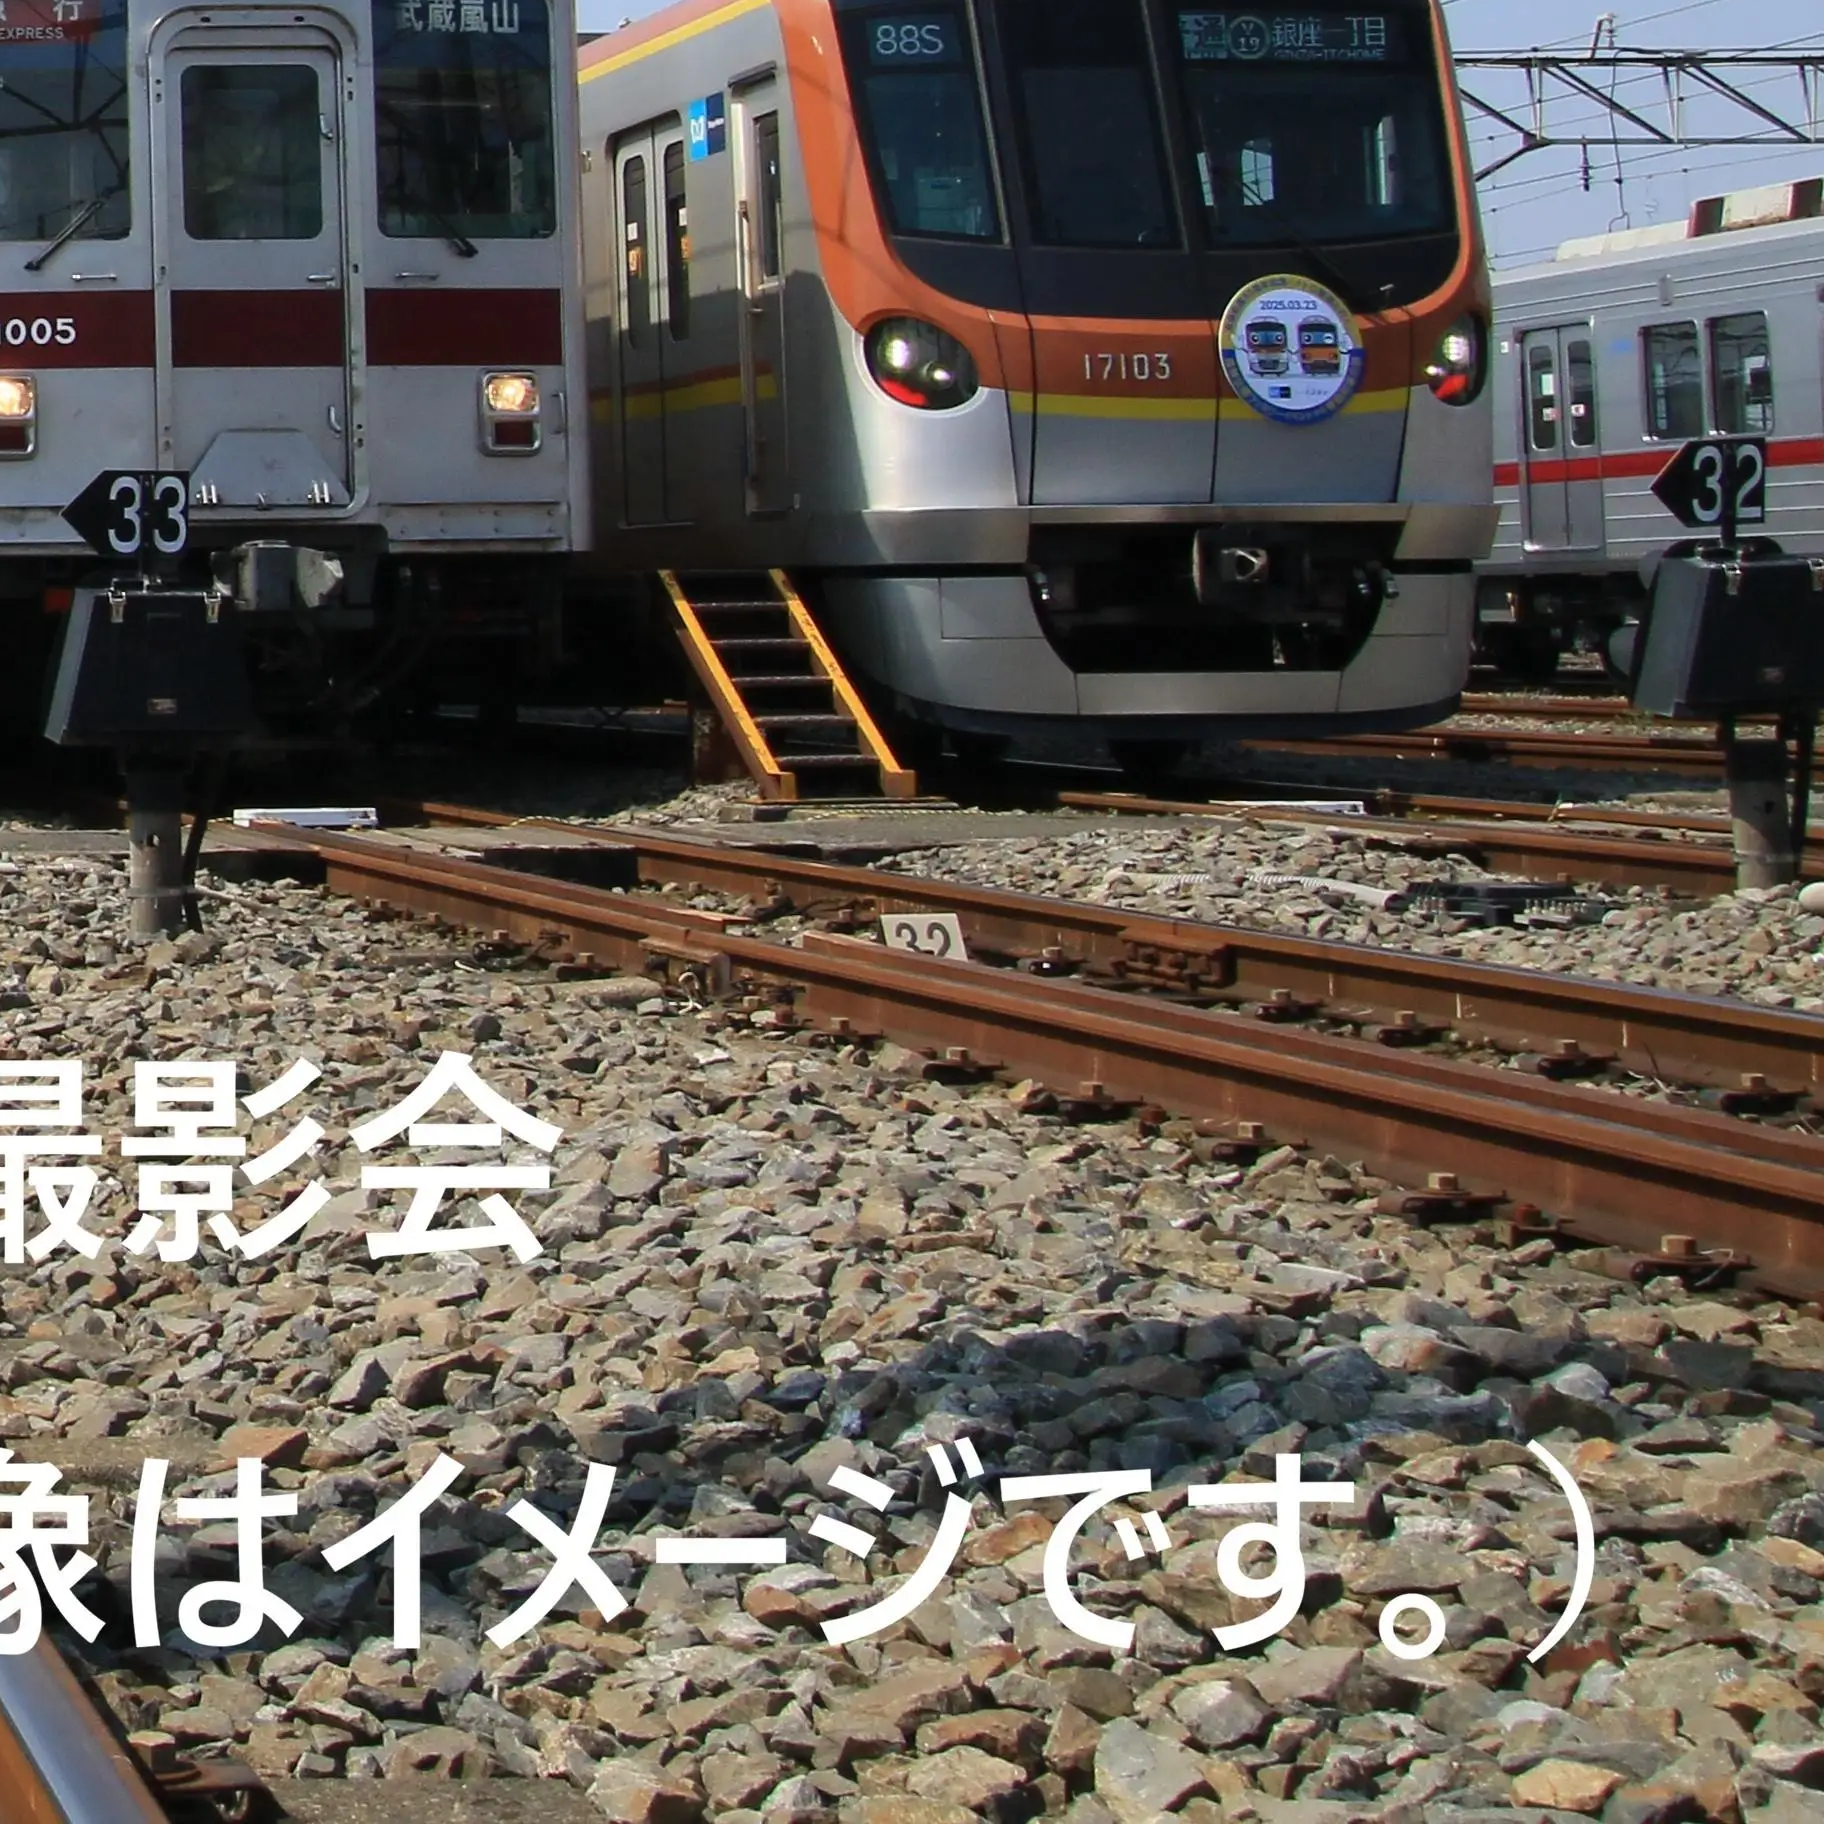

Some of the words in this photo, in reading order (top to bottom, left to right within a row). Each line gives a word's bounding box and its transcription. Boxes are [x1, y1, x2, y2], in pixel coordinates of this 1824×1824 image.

[876, 24, 944, 55] 88S
[1272, 17, 1386, 46] 銀座一丁目
[1260, 300, 1317, 310] 2025.03.23
[1085, 354, 1170, 380] 17103
[1691, 444, 1763, 522] 32
[108, 476, 187, 553] 33
